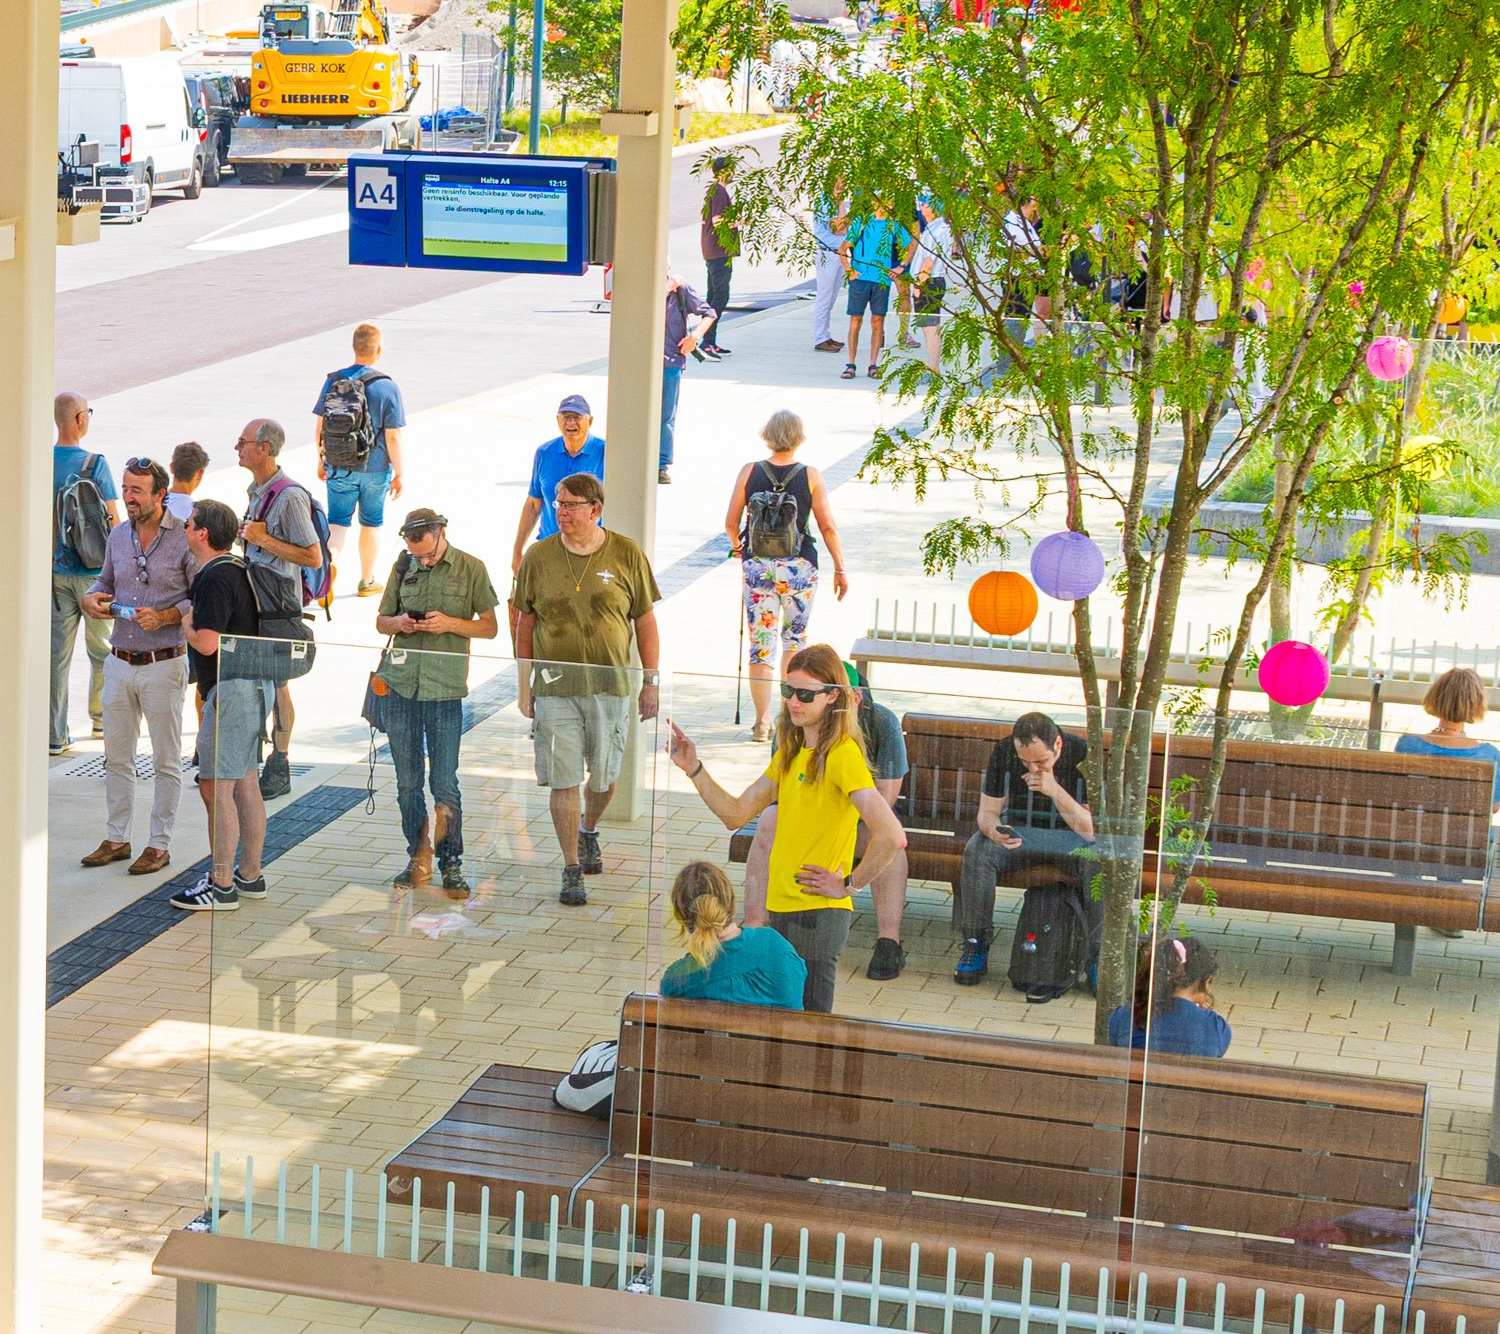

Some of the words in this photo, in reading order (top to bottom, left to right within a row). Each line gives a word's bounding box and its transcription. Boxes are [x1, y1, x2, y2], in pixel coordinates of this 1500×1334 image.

[320, 63, 346, 73] KOK
[281, 94, 350, 104] LIEBHERR
[480, 177, 500, 185] Halte
[549, 180, 568, 188] 12:15
[358, 183, 396, 205] A4
[445, 205, 455, 213] zie
[456, 206, 505, 216] dienstregeling
